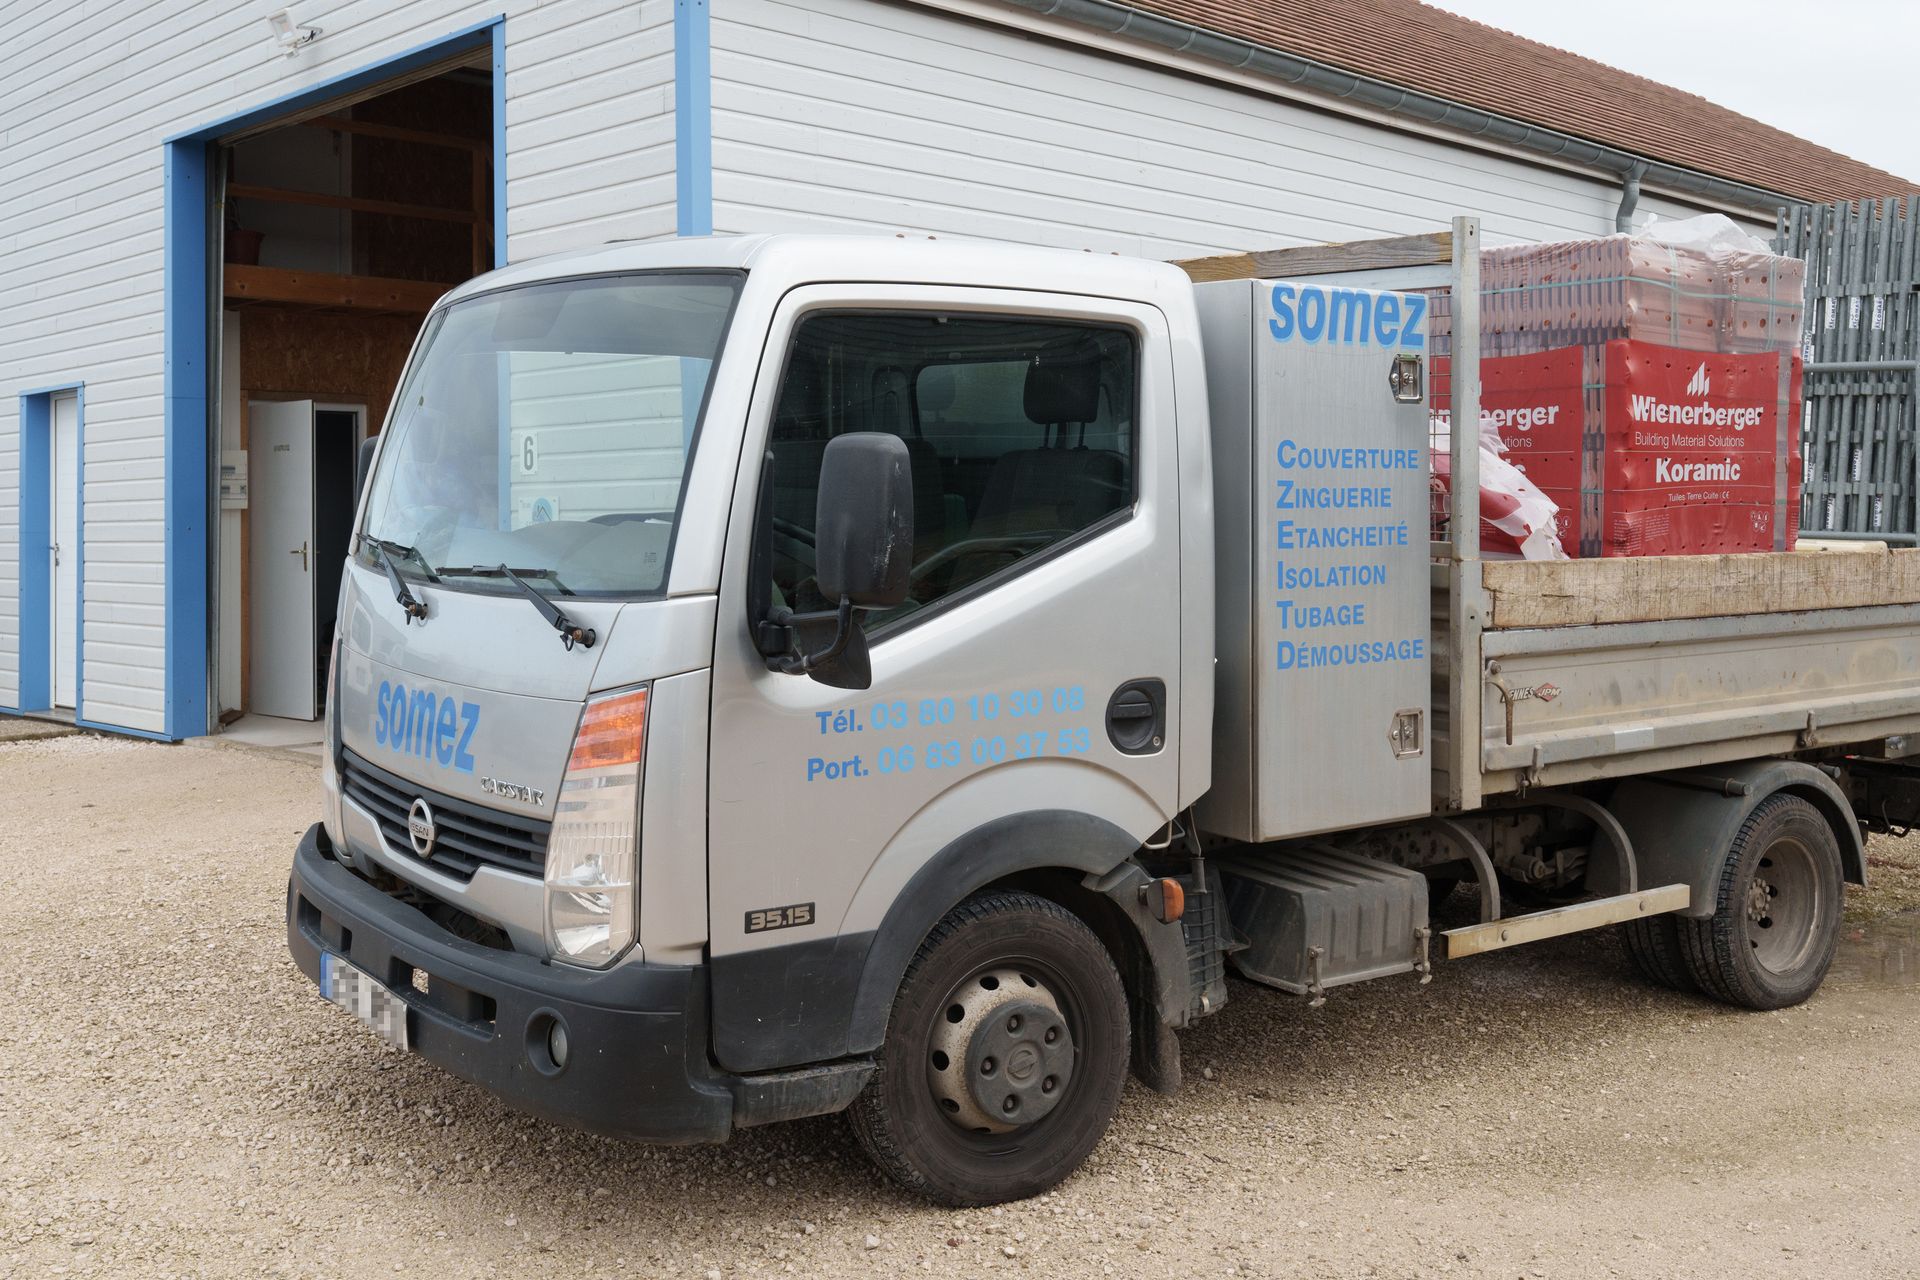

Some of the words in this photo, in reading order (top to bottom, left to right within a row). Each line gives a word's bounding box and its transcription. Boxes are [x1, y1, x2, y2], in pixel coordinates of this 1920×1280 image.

[1269, 282, 1427, 349] somez
[1632, 394, 1763, 430] Wienerberger
[524, 436, 533, 470] 6
[1277, 439, 1419, 469] COUVERTURE
[1635, 432, 1669, 449] Building
[1672, 433, 1705, 447] Material
[1708, 435, 1744, 447] Solutions
[1656, 457, 1741, 483] Koramic
[1276, 480, 1392, 509] ZINGUERIE
[1277, 560, 1386, 590] ISOLATION
[1276, 600, 1365, 630] TUBAGE
[1538, 687, 1560, 697] JPM
[375, 680, 480, 773] somez
[816, 709, 863, 734] Tél.
[870, 701, 908, 730] 03
[918, 697, 955, 726] 80
[969, 692, 1000, 721] 10
[1009, 689, 1043, 718] 30
[807, 755, 869, 781] Port.
[878, 745, 915, 774] 06
[925, 740, 961, 770] 83
[972, 736, 1006, 764] 00
[480, 776, 544, 806] CABSTAR
[751, 905, 811, 930] 35.15
